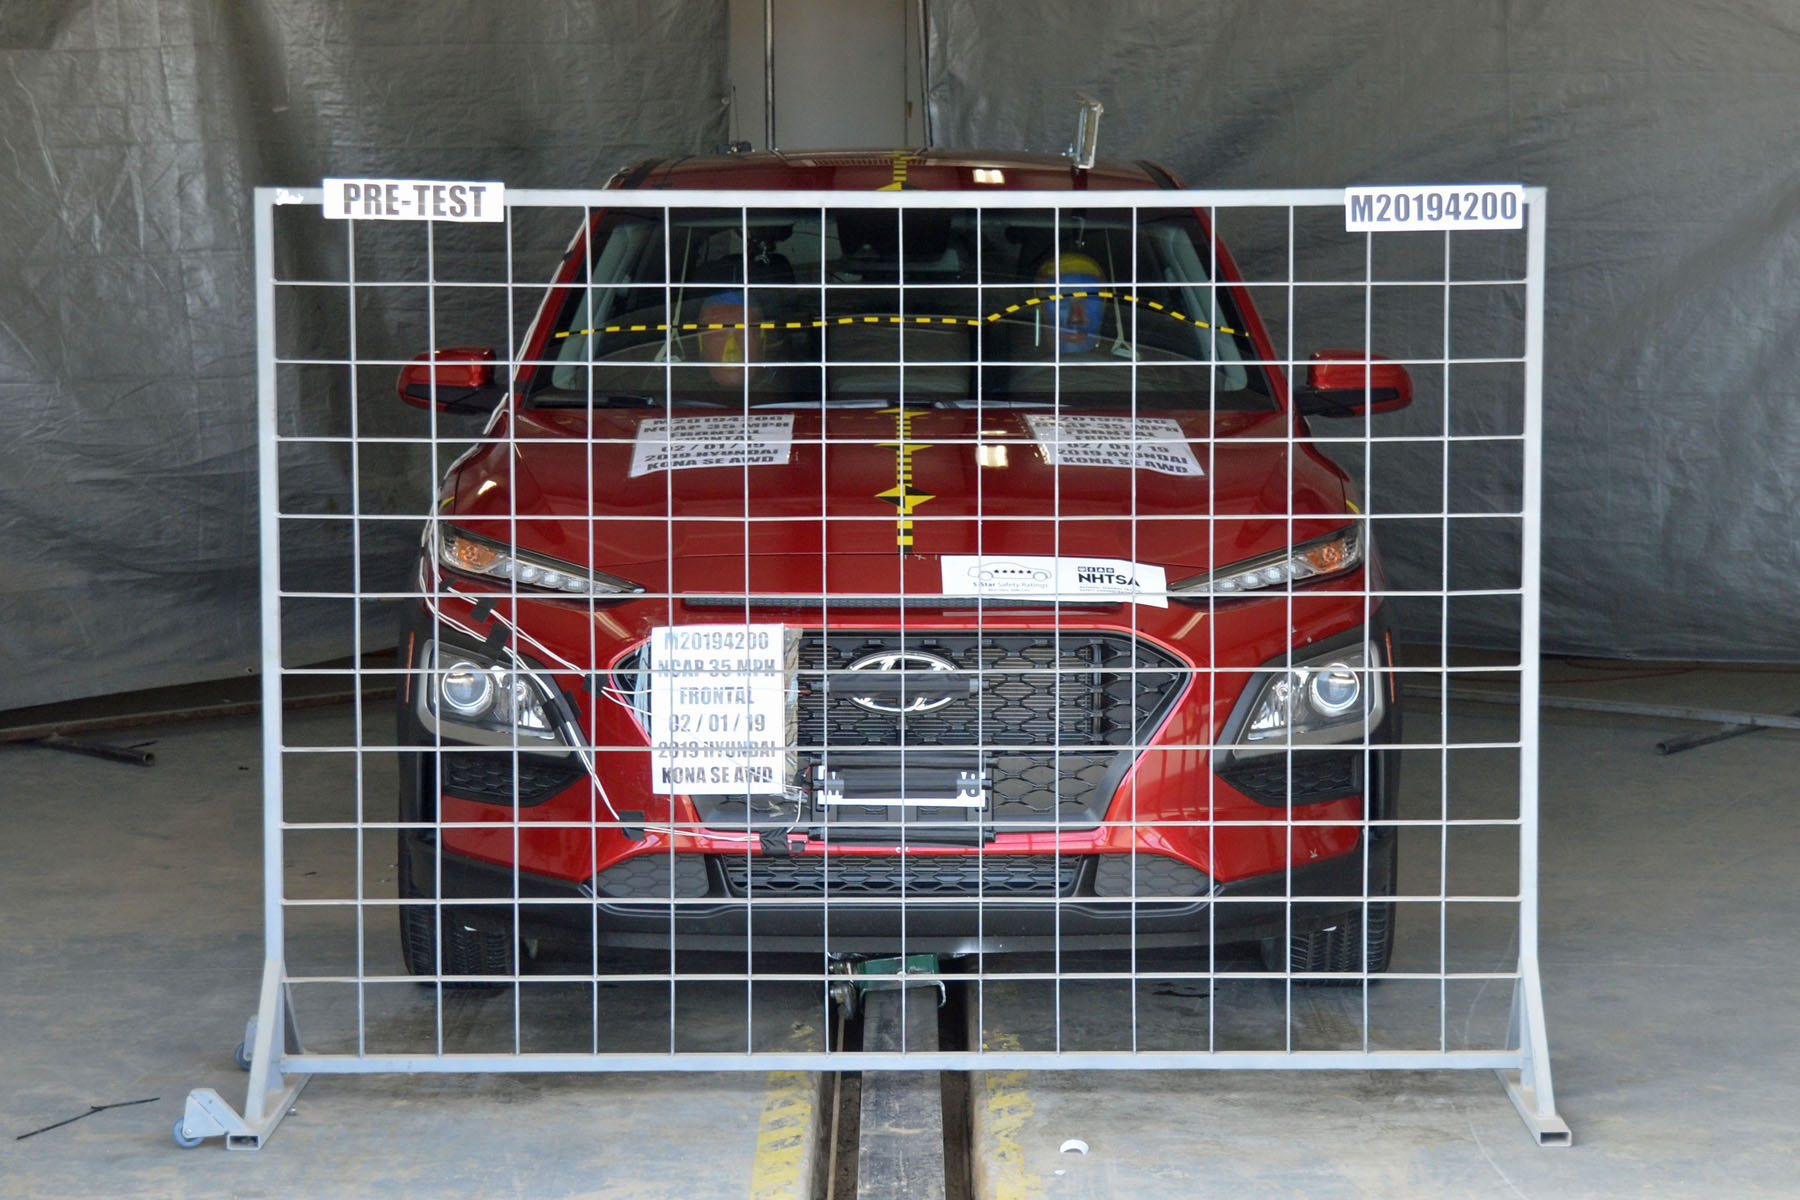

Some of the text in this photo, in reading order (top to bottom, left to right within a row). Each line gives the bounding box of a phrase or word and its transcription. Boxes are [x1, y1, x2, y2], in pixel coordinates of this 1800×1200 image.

[343, 183, 486, 218] PRE-TEST
[1351, 191, 1517, 223] M20194200
[695, 449, 779, 457] HYUNDAI
[646, 455, 774, 470] KONA SE AWD
[1062, 456, 1114, 464] KONA
[1145, 461, 1189, 473] AWD
[1078, 572, 1141, 587] NHTSA
[664, 632, 769, 651] M20194200
[658, 659, 776, 678] NCAP 35 MPH
[679, 686, 755, 705] FRONTAL
[708, 714, 728, 732] 01
[658, 741, 776, 759] 2019 HYUNDAI
[662, 766, 773, 784] KONA SE AWD
